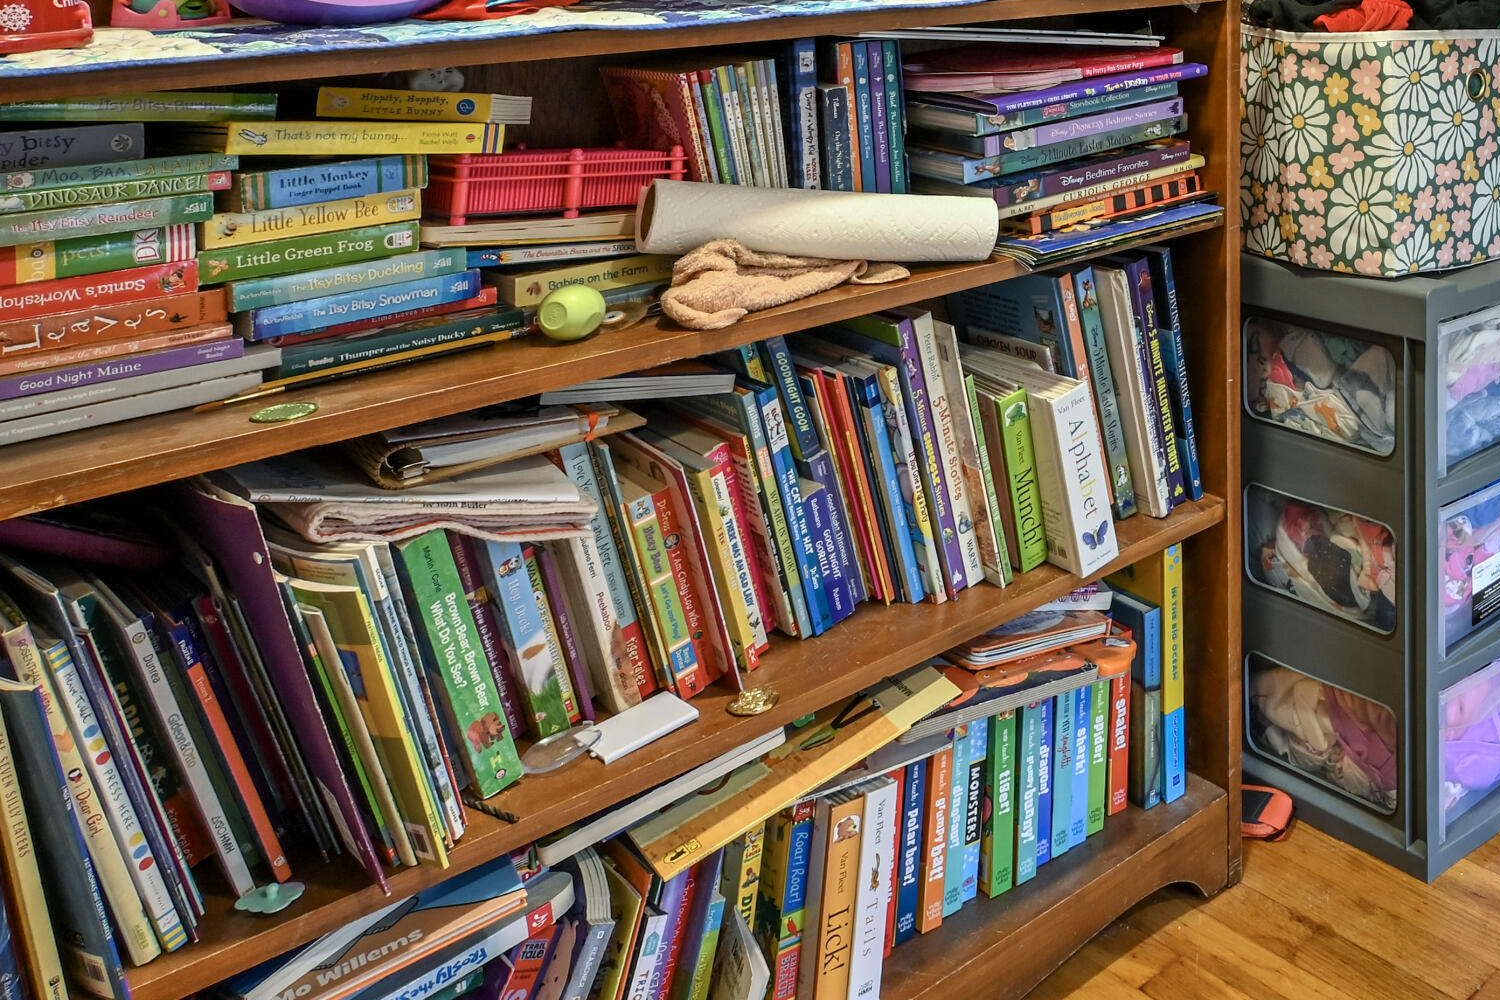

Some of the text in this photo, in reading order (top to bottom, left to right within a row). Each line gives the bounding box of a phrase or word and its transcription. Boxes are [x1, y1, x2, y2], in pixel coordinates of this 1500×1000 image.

[1069, 92, 1130, 110] Storybook Collection
[21, 136, 75, 153] bitsy
[275, 128, 311, 141] That's
[315, 130, 336, 141] not
[340, 132, 358, 145] my
[29, 174, 203, 209] DINOSAUR DANCE!
[279, 169, 369, 189] Little Monkey
[1060, 160, 1150, 187] Disney Bedtime Favorites
[1062, 184, 1108, 202] CURIOUS
[1112, 174, 1151, 192] GEORGE
[97, 207, 160, 225] Reindeer
[251, 200, 379, 233] Little Yellow Bee
[136, 230, 162, 261] DK
[236, 238, 374, 269] Little Green Frog
[86, 278, 146, 298] Santa's
[308, 260, 424, 292] Itsy Bitsy Duckling
[548, 264, 649, 291] Babies on the Farm
[313, 287, 439, 318] The Itsy Bitsy Snowman
[338, 345, 385, 362] Thumper
[411, 333, 437, 348] Noisy
[437, 329, 467, 346] Ducky
[923, 333, 933, 354] Peter
[1167, 289, 1191, 409] DIVING SHARKS
[19, 361, 142, 392] Good Night Maine
[775, 351, 810, 432] GOODNIGHT GOON
[1148, 328, 1180, 474] 5-MINUTE HALLOWEEN STORIES
[747, 405, 761, 439] Willems
[932, 395, 963, 502] 5-Minute Stories
[571, 460, 589, 481] Love
[1068, 419, 1099, 520] Alphabet
[768, 490, 778, 505] WE
[773, 506, 783, 525] ARE
[786, 468, 814, 556] THE CAT IN THE HAT
[934, 484, 946, 518] Stories
[1014, 465, 1044, 550] Munch!
[591, 523, 615, 567] and More
[724, 518, 738, 541] THERE
[729, 540, 742, 558] WAS
[777, 525, 785, 537] IN
[823, 528, 835, 553] GOOD
[827, 492, 849, 567] Good Night Dinosaur
[421, 545, 443, 593] Martin Carle
[586, 561, 597, 578] Ferri
[672, 557, 684, 571] Am
[734, 558, 745, 572] AN
[815, 540, 831, 578] GORILLA
[966, 539, 978, 570] WARNE
[676, 570, 695, 612] Cindy-Lou
[737, 570, 750, 589] OLD
[741, 587, 755, 607] LADY
[507, 577, 532, 637] Hey, Duck!
[595, 590, 613, 632] Peekaboo
[687, 608, 701, 627] Who
[16, 637, 42, 686] ROSENTHAL
[430, 599, 467, 689] What Do You See?
[445, 592, 491, 712] Brown Bear, Brown Bear,
[475, 608, 508, 697] How to Babysit Grandma
[625, 636, 647, 687] tiger tales
[142, 653, 161, 684] Dunrea
[1092, 714, 1105, 766] spider!
[1114, 697, 1128, 752] snake!
[1038, 744, 1051, 796] dragon!
[1074, 726, 1087, 776] shark!
[0, 755, 32, 859] SEVEN SILLY EATERS
[103, 768, 135, 831] PRESS HERE
[876, 798, 886, 818] Van
[965, 766, 981, 841] MONSTERS
[998, 769, 1011, 817] tiger!
[75, 789, 105, 839] Dear Girl,
[934, 797, 947, 845] grumpy
[949, 784, 965, 850] dinosaur!
[1021, 785, 1037, 845] bunny!
[788, 831, 809, 904] Roar! Roar!
[902, 849, 917, 888] bear!
[929, 842, 945, 883] bat!
[822, 904, 850, 976] Lick!
[863, 897, 879, 958] Tails
[315, 928, 425, 987] Willems
[578, 946, 598, 988] REASONER
[777, 955, 790, 999] BRAUN
